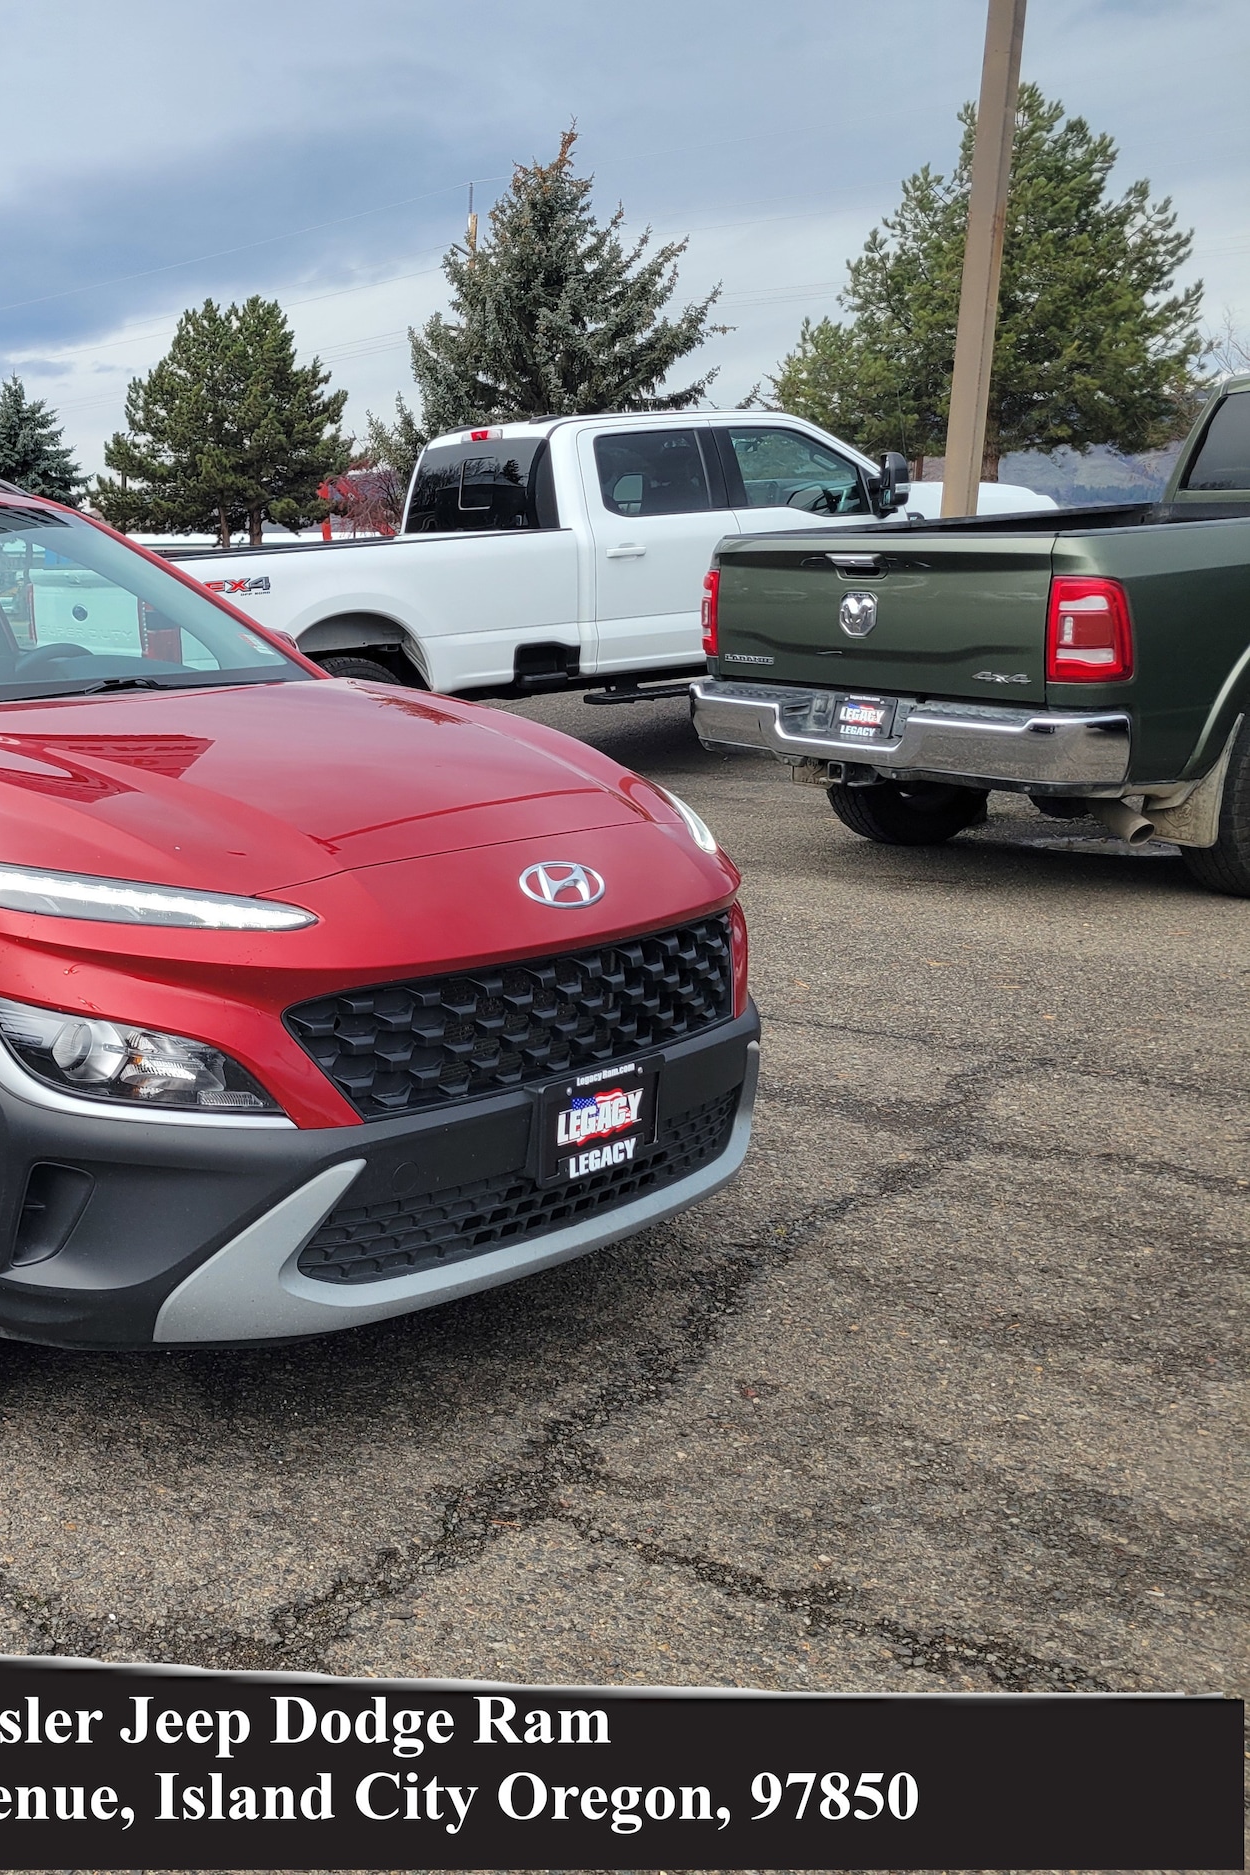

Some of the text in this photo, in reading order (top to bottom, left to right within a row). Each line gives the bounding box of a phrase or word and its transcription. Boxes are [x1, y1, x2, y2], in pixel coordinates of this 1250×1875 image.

[839, 706, 885, 724] LEGACY
[840, 725, 876, 737] LEGACY
[557, 1091, 644, 1145] LEGACY
[569, 1137, 637, 1179] LEGACY
